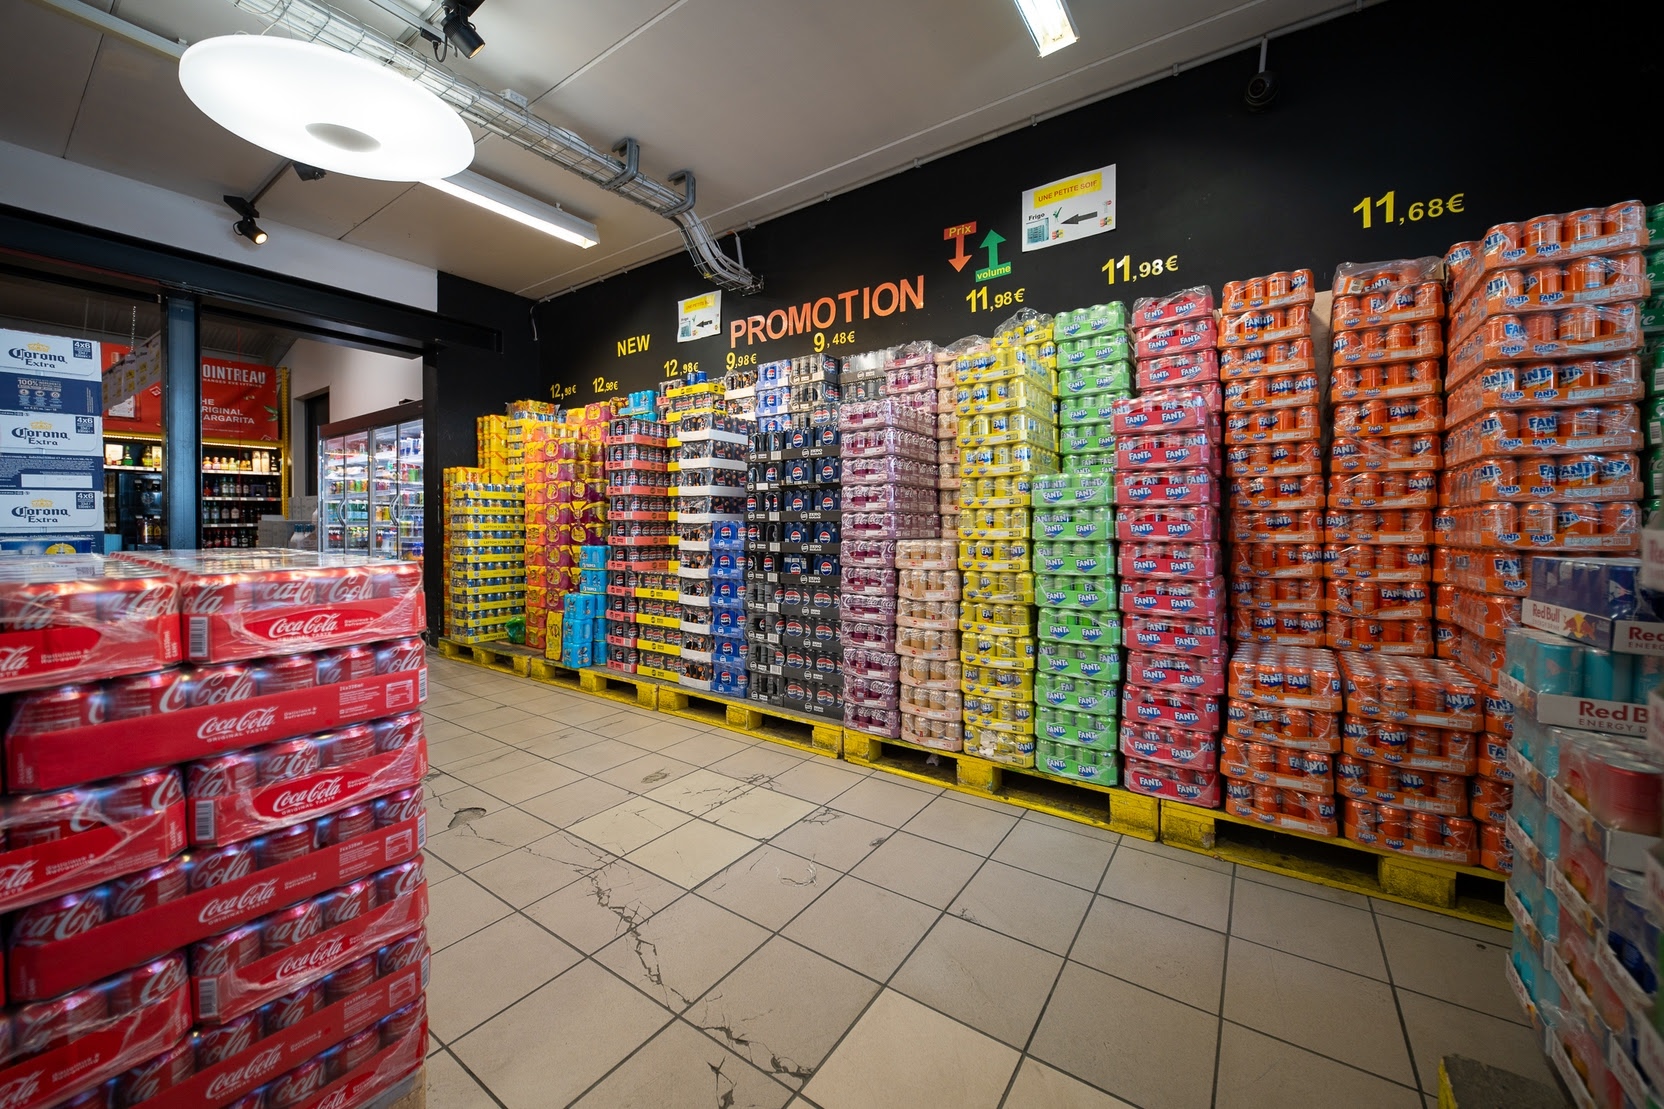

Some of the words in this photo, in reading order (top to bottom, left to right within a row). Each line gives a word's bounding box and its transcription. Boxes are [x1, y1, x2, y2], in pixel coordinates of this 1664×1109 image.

[1038, 192, 1052, 203] UNE
[1053, 184, 1079, 198] PETITE
[1080, 179, 1098, 193] SOIF
[1353, 190, 1465, 229] 11,68€
[1028, 212, 1046, 223] Frigo
[948, 224, 972, 237] Prix
[1536, 244, 1560, 253] FANTA
[1502, 250, 1526, 258] FANTA
[976, 264, 1011, 281] volume
[1101, 254, 1179, 285] 11,98€
[965, 286, 1025, 313] 11,98€
[730, 274, 924, 349] PROMOTION
[1175, 303, 1196, 313] FANTA
[1144, 309, 1163, 319] FANTA
[1091, 318, 1108, 326] FANTA
[1064, 323, 1080, 332] FANTA
[812, 330, 856, 353] 9,48€
[1180, 334, 1200, 344] FANTA
[74, 341, 91, 349] 4x6
[616, 334, 651, 357] NEW
[8, 347, 68, 364] Corona
[25, 358, 56, 369] Extra
[725, 351, 757, 371] 9,98€
[663, 358, 699, 378] 12,98€
[1181, 366, 1201, 375] FANTA
[202, 364, 266, 385] OINTREAU
[1150, 371, 1169, 379] FANTA
[201, 398, 215, 406] HE
[201, 406, 243, 416] RIGINAL
[1162, 411, 1185, 420] FANTA
[203, 414, 255, 425] ARGARITA
[11, 427, 71, 440] Corona
[28, 437, 58, 446] Extra
[1129, 451, 1151, 460] FANTA
[1166, 449, 1190, 458] FANTA
[1043, 490, 1062, 498] FANTA
[1166, 486, 1190, 495] FANTA
[11, 506, 71, 519] Corona
[28, 515, 58, 523] Extra
[1171, 599, 1195, 607] FANTA
[1532, 603, 1545, 619] Red
[1546, 606, 1561, 623] Bull
[1137, 634, 1160, 642] FANTA
[1627, 642, 1664, 651] ENERG
[1143, 670, 1166, 678] FANTA
[1180, 675, 1204, 683] FANTA
[1138, 707, 1161, 715] FANTA
[1579, 701, 1628, 722] Red
[1175, 712, 1199, 721] FANTA
[1579, 718, 1635, 732] ENERGY
[207, 731, 244, 742] ORIGINAL
[246, 726, 268, 736] TASTE
[1078, 731, 1098, 739] FANTA
[1135, 742, 1158, 751] FANTA
[1172, 749, 1195, 758] FANTA
[1078, 766, 1098, 774] FANTA
[1140, 777, 1163, 786] FANTA
[1177, 785, 1200, 794] FANTA
[282, 803, 314, 815] ORIGINAL
[315, 796, 336, 806] TASTE
[246, 900, 269, 914] TASTE
